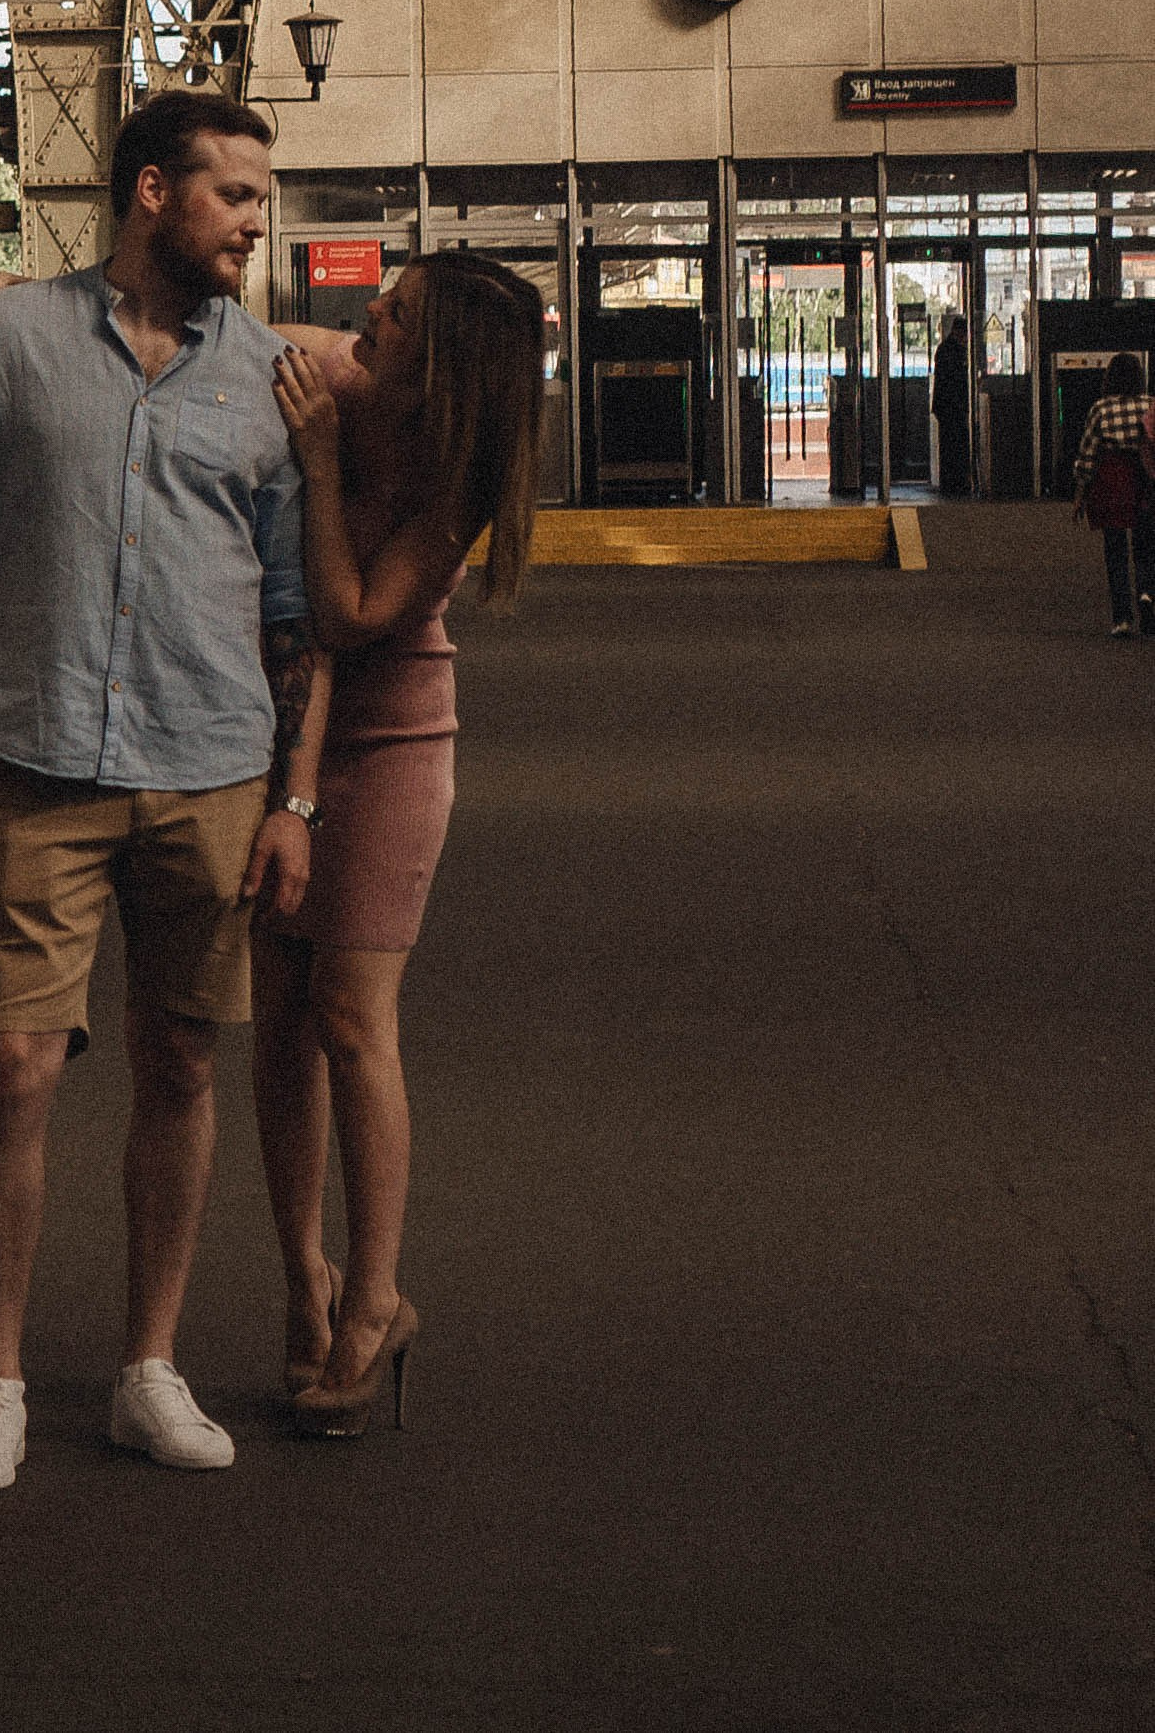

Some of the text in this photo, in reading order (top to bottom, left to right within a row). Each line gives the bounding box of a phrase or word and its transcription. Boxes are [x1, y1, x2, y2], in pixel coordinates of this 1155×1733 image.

[874, 79, 956, 90] Вход запрещен
[874, 92, 911, 101] No entry
